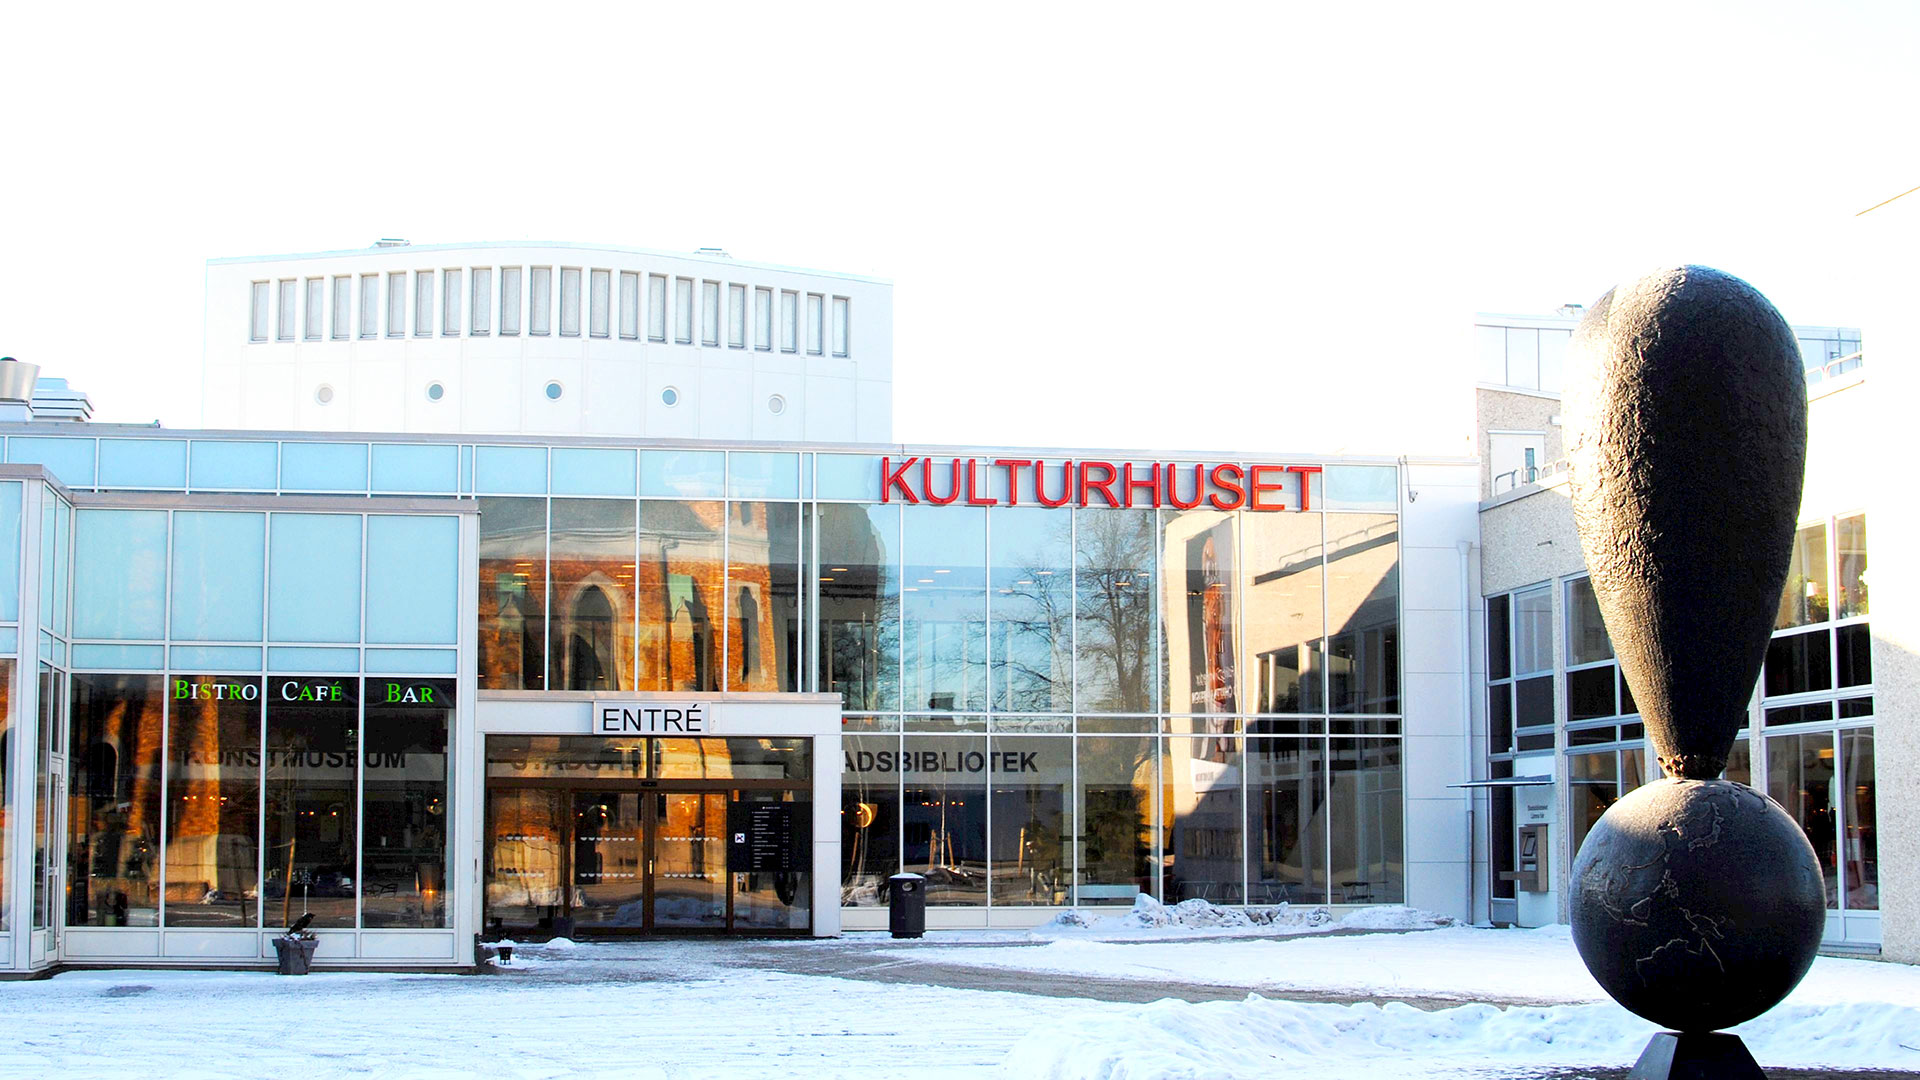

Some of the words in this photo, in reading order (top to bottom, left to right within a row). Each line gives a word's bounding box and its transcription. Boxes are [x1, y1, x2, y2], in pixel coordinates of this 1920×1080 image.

[881, 457, 1323, 512] KULTURHUSET
[174, 680, 258, 700] BISTRO
[282, 681, 342, 701] CAFÉ
[387, 683, 434, 703] BAR
[602, 704, 702, 732] ENTRÉ
